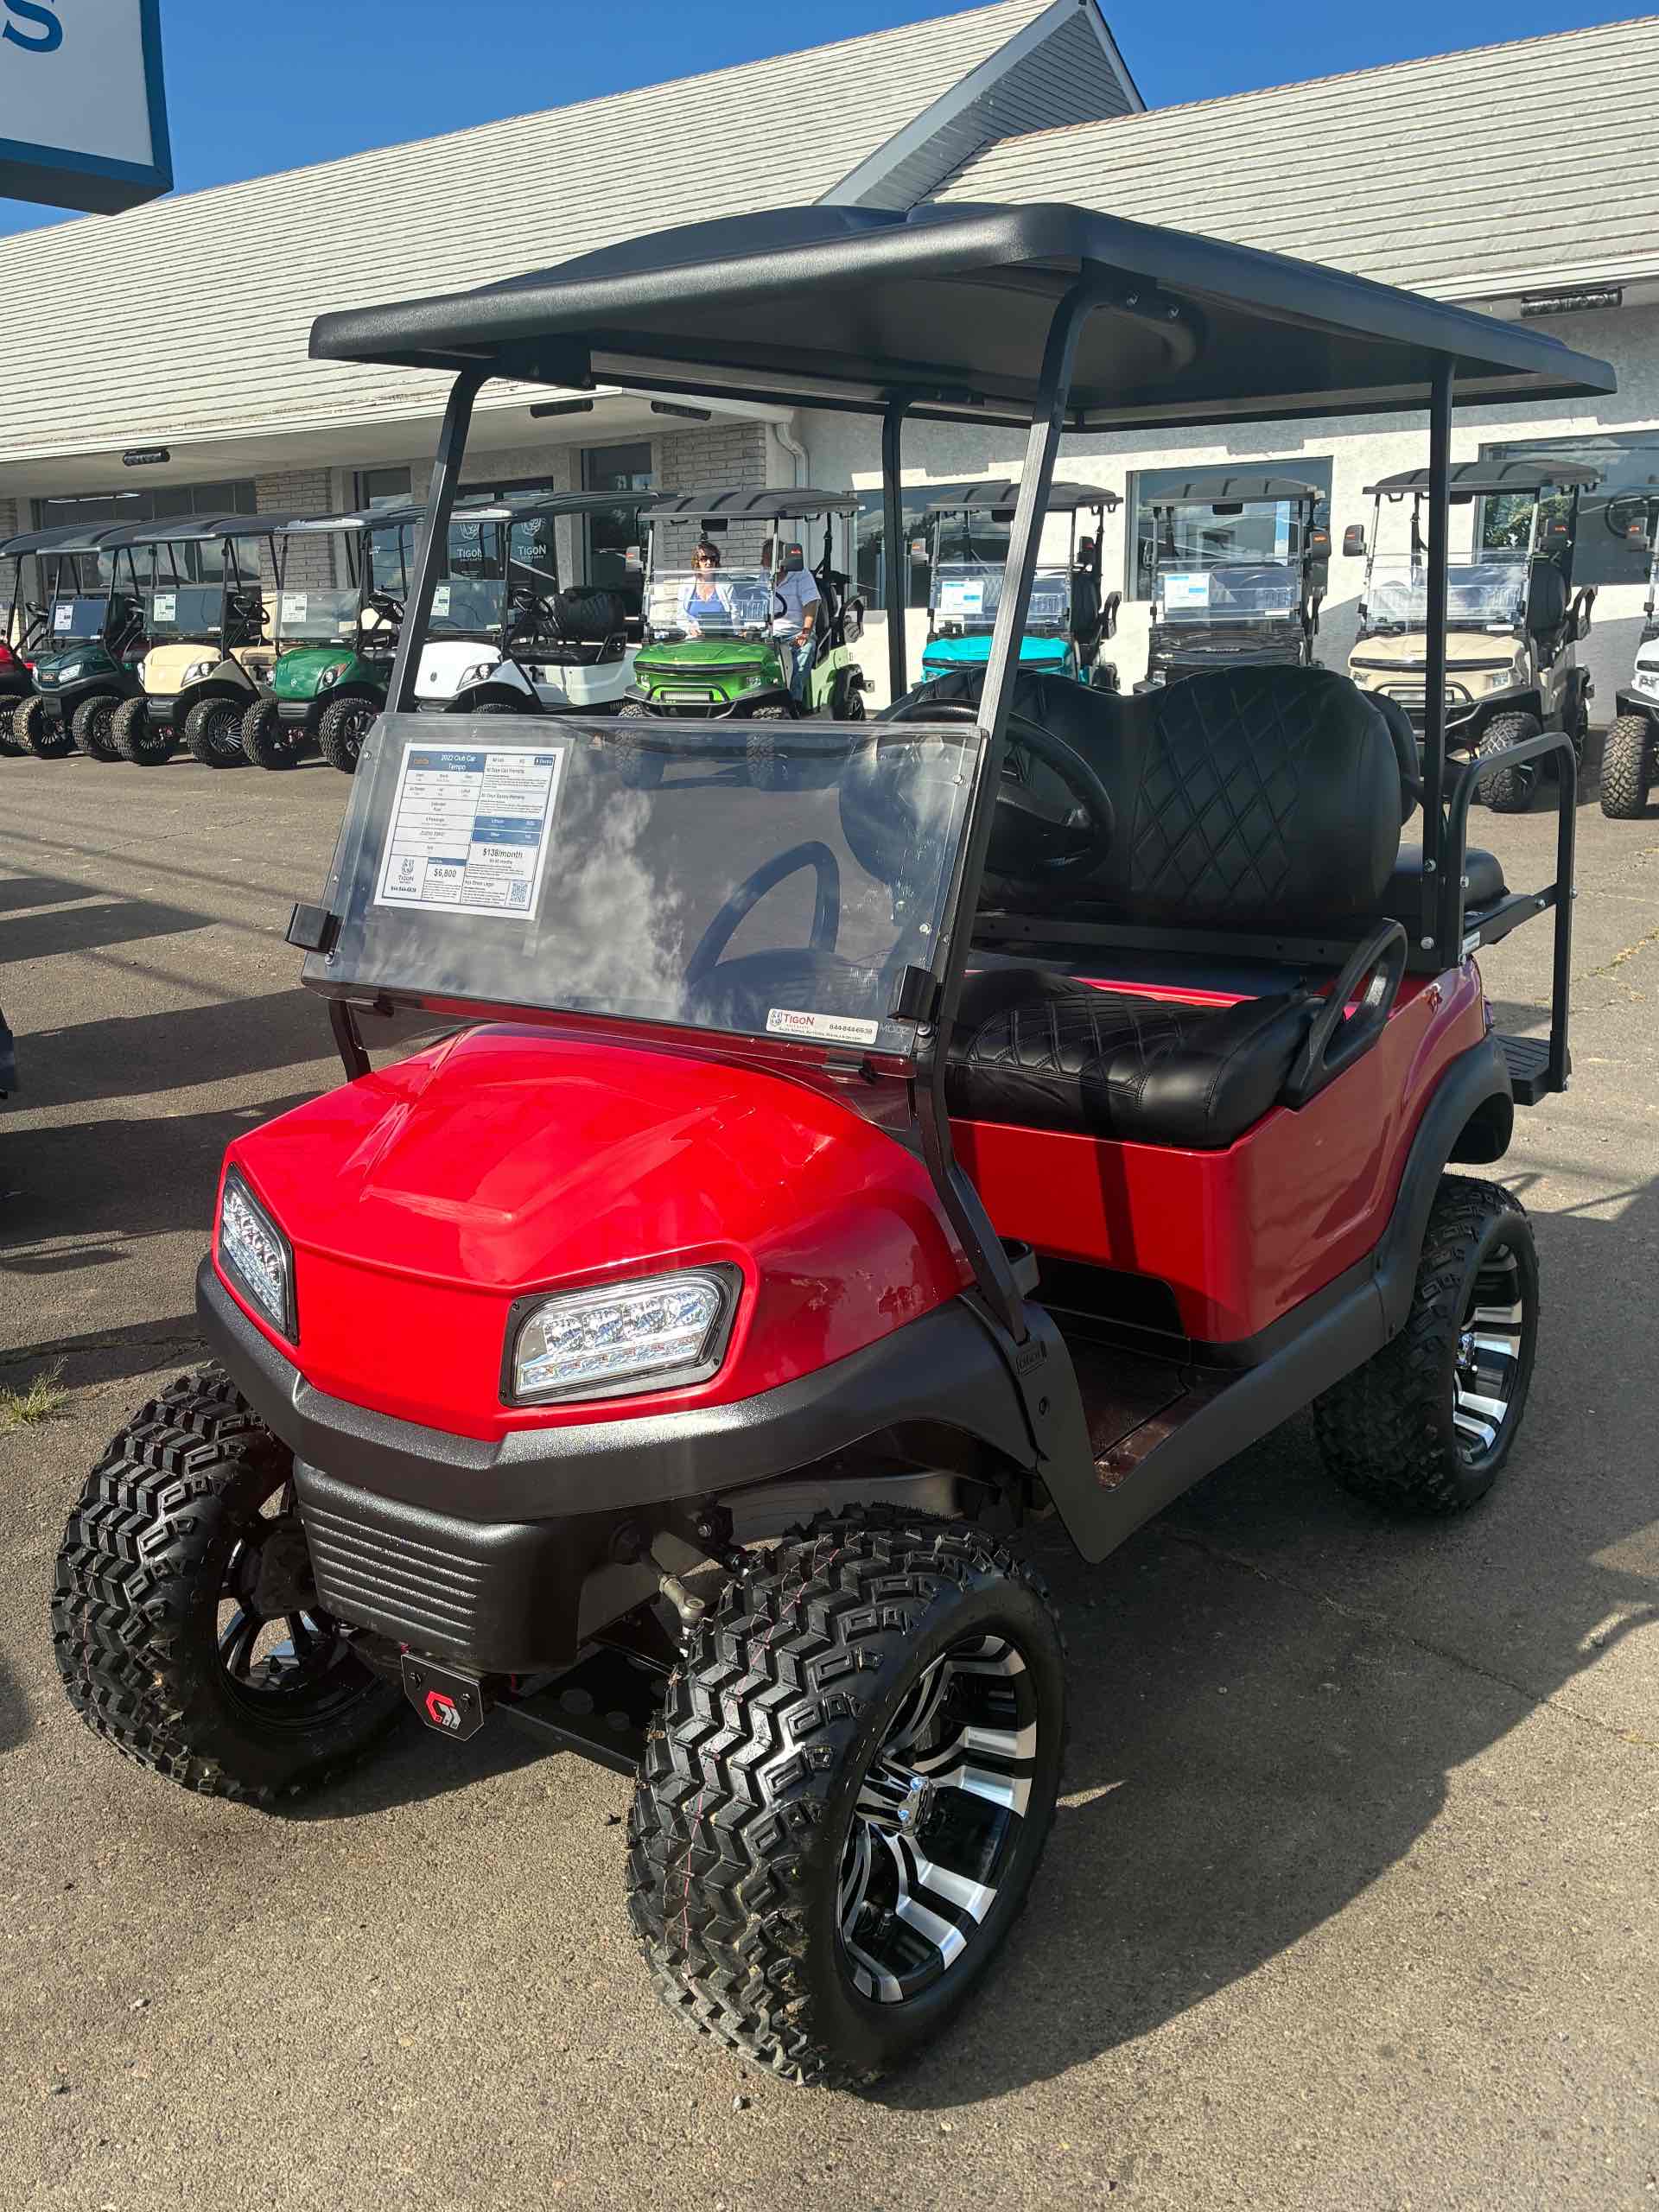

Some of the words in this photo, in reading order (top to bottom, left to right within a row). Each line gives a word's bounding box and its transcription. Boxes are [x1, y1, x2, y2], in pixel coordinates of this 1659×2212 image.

[3, 0, 63, 53] S
[518, 544, 547, 556] TIGON
[483, 848, 523, 858] $138/month
[434, 868, 457, 878] $6,800
[784, 1014, 815, 1026] TIGON
